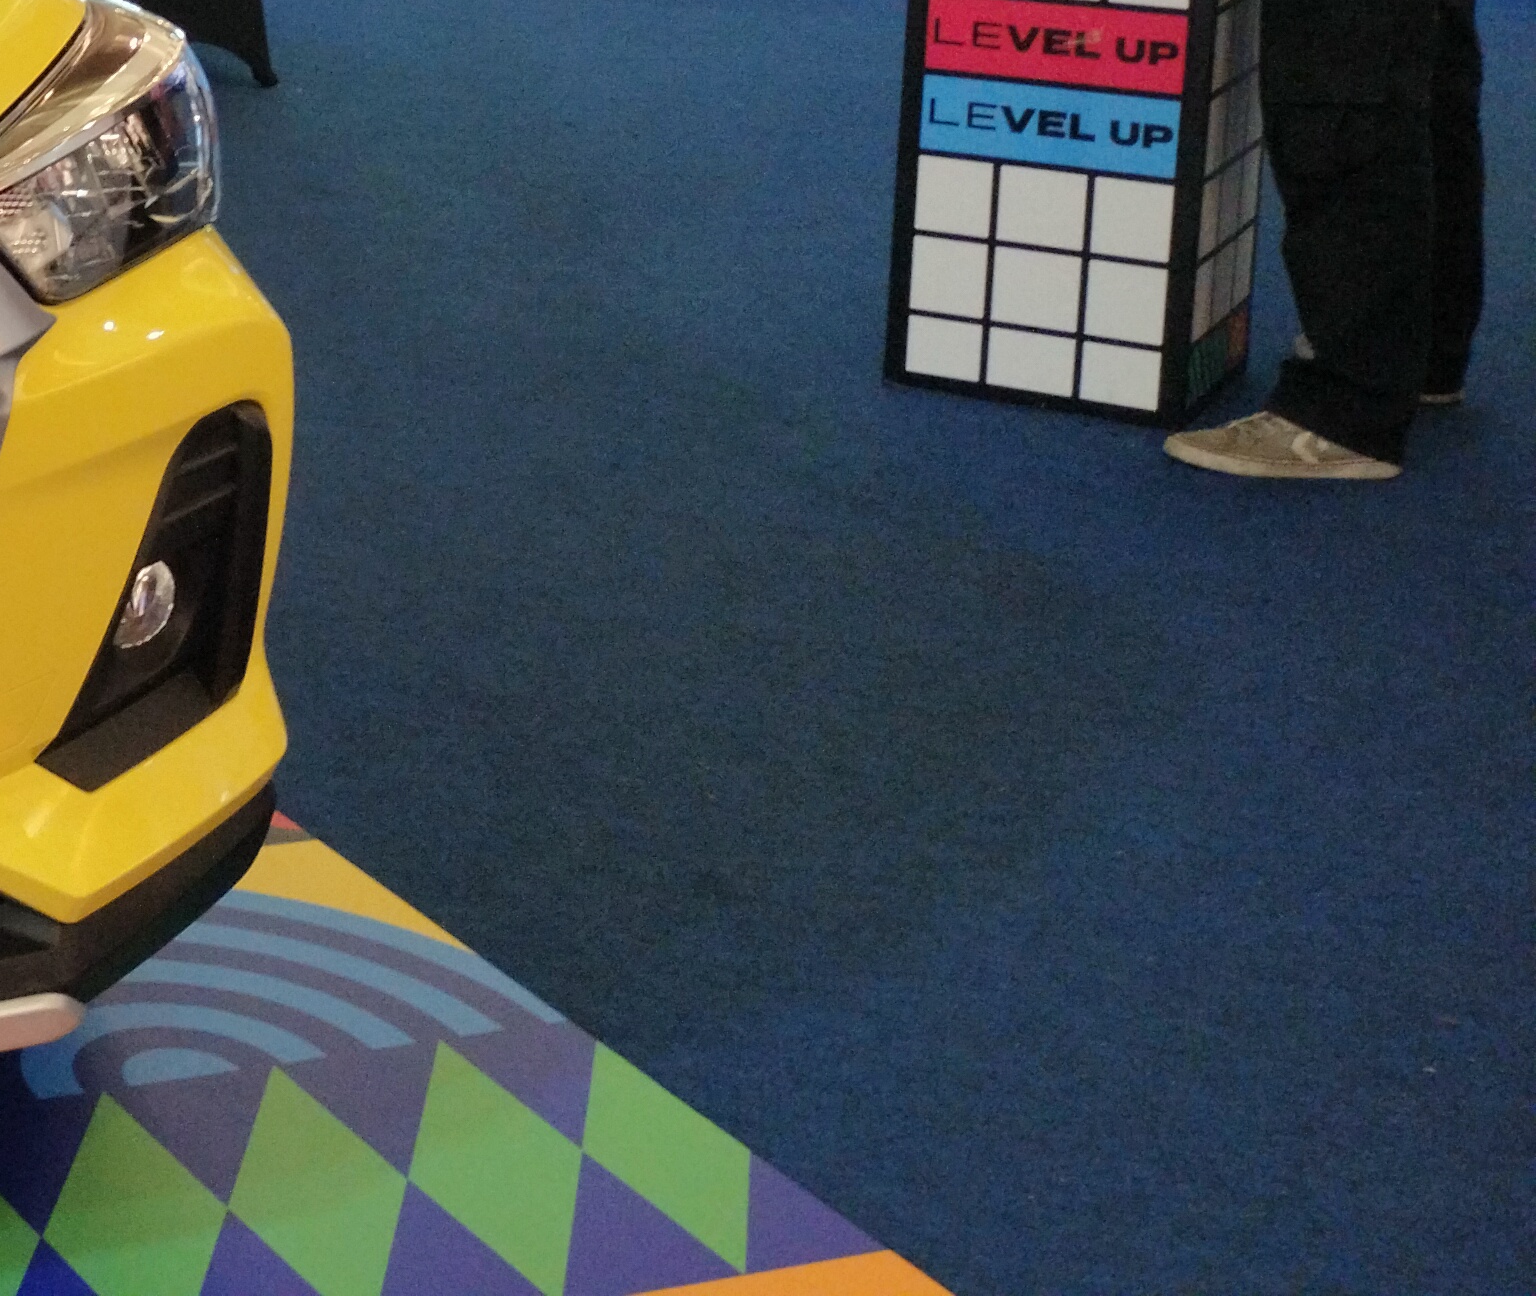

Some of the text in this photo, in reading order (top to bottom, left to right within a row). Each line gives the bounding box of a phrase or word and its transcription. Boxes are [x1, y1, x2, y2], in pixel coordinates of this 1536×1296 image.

[933, 18, 1180, 66] LEVEL UP
[929, 98, 1175, 149] LEVEL UP
